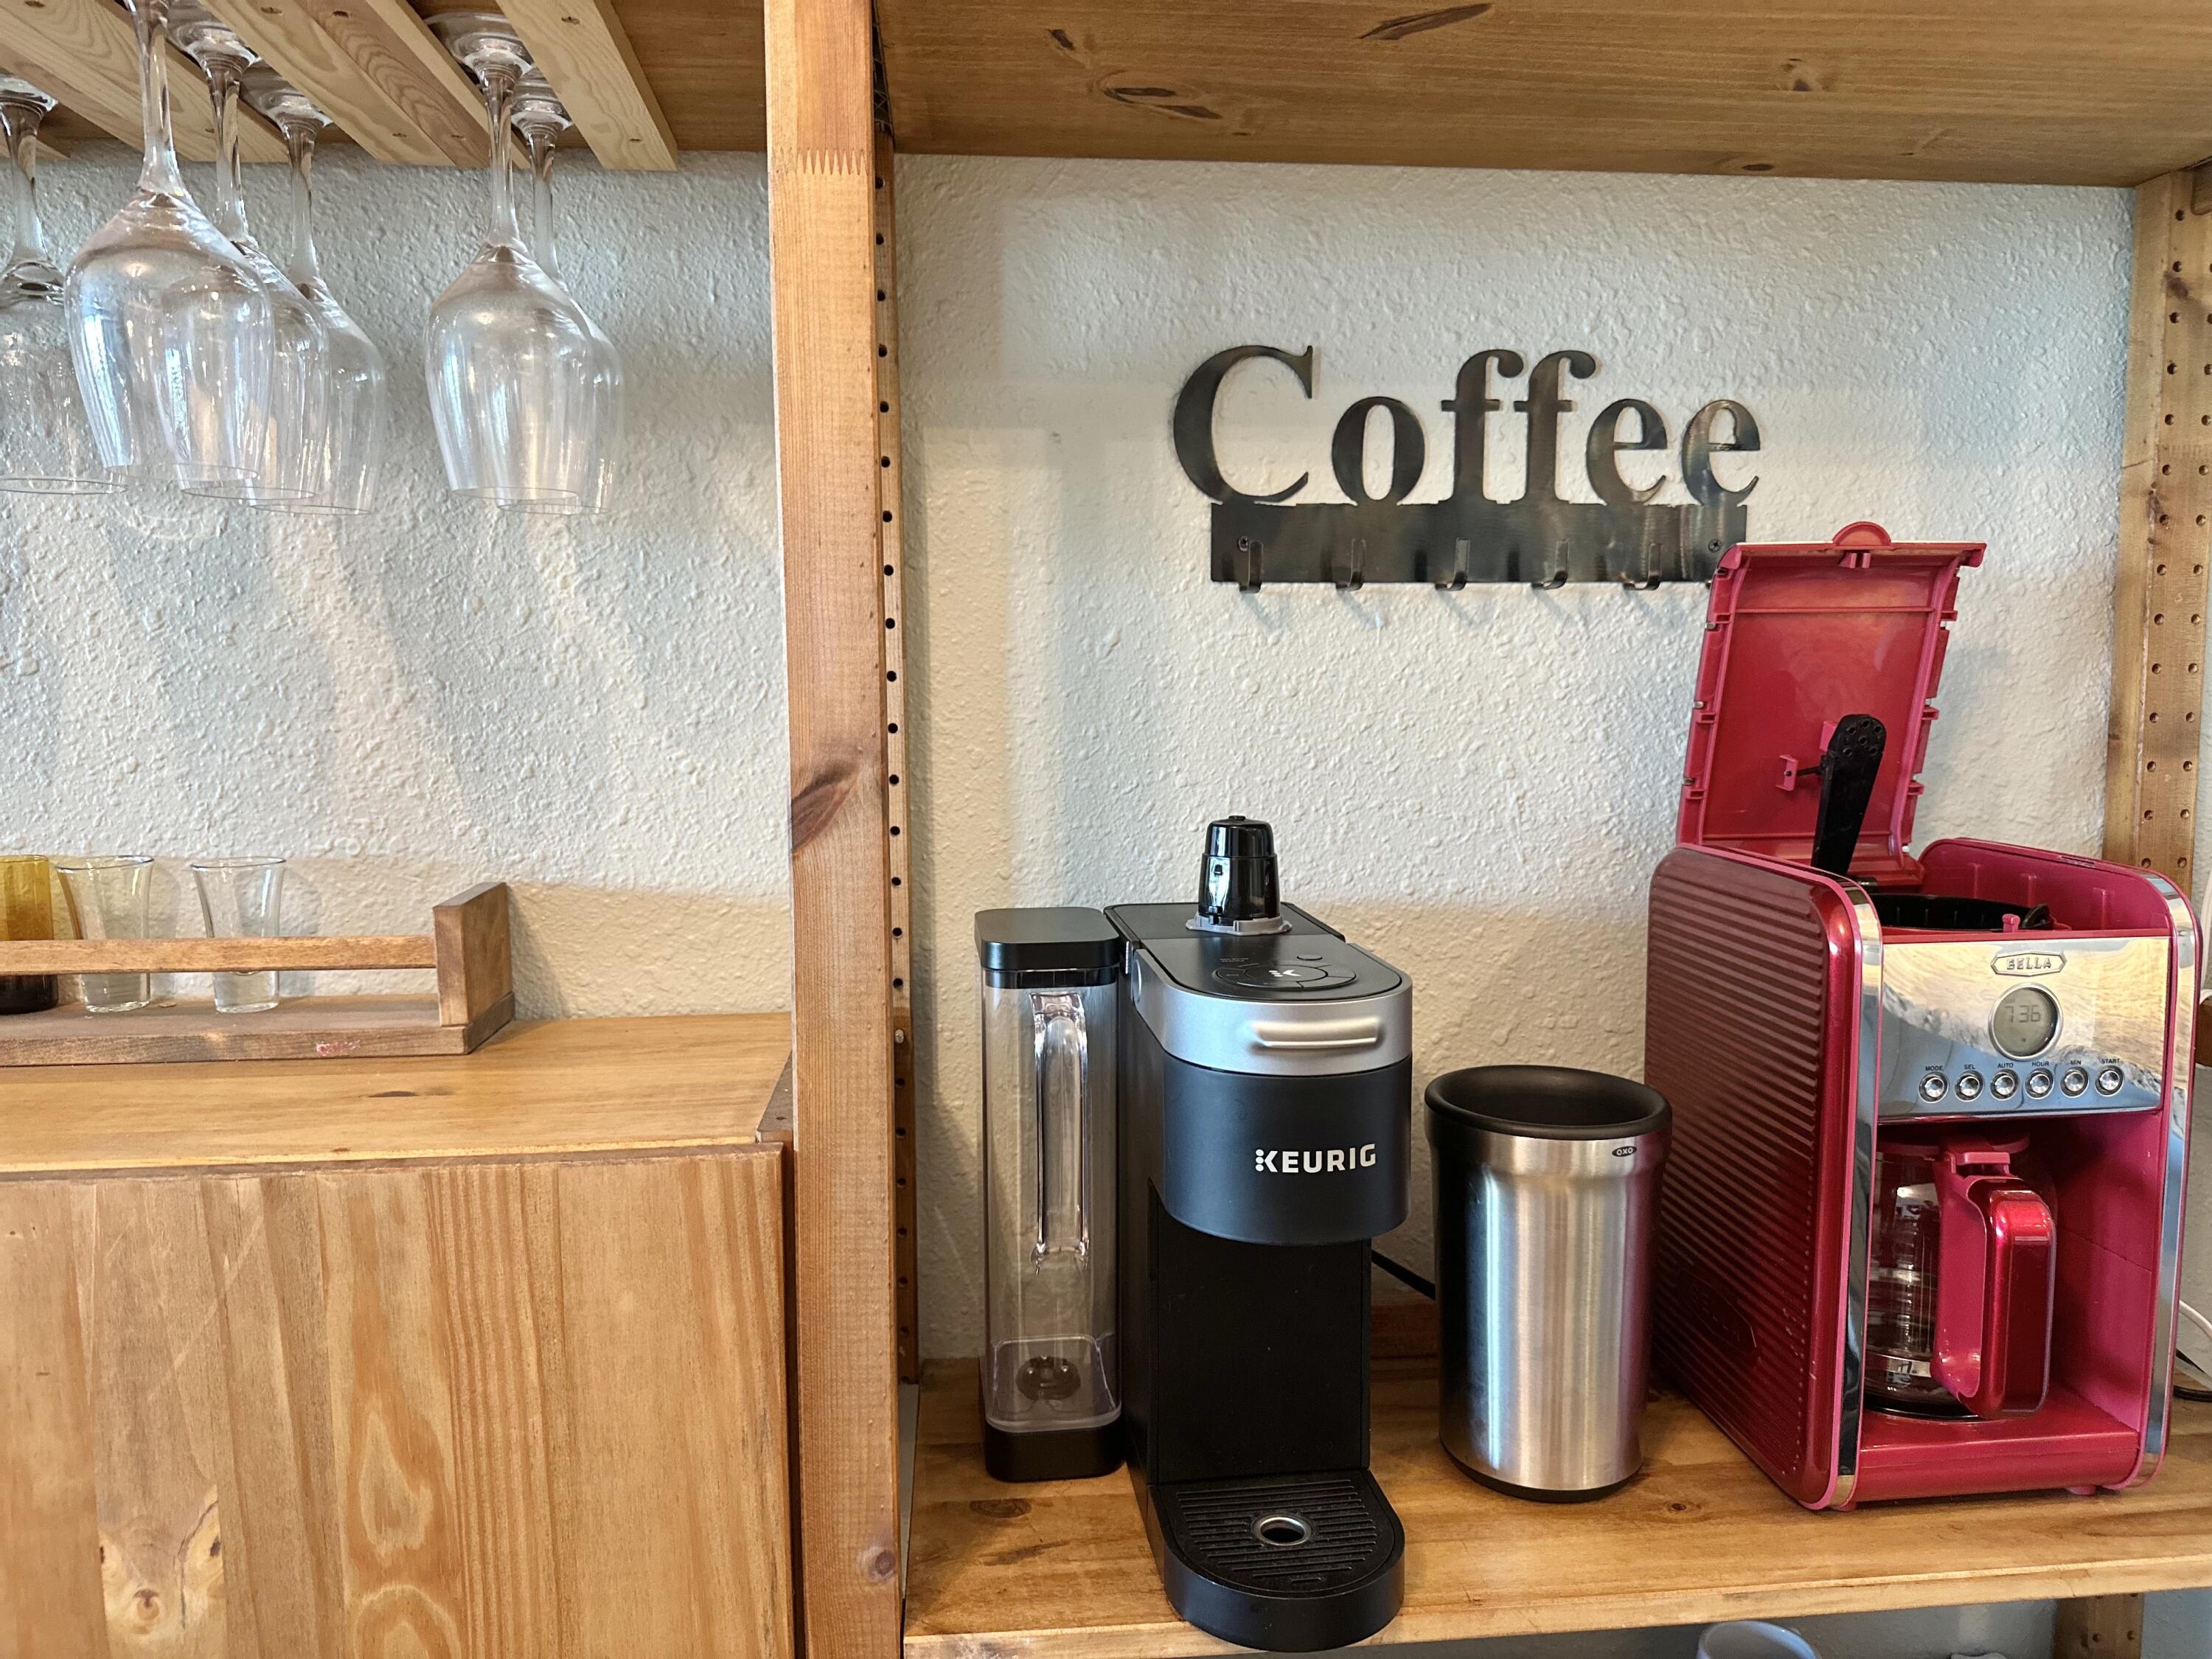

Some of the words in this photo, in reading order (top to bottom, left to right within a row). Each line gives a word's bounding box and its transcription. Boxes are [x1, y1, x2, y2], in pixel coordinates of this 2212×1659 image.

[1173, 344, 1761, 505] Coffee
[2006, 956, 2052, 970] BELLA
[1255, 1143, 1376, 1174] KEURIG
[1615, 1147, 1634, 1156] OXO
